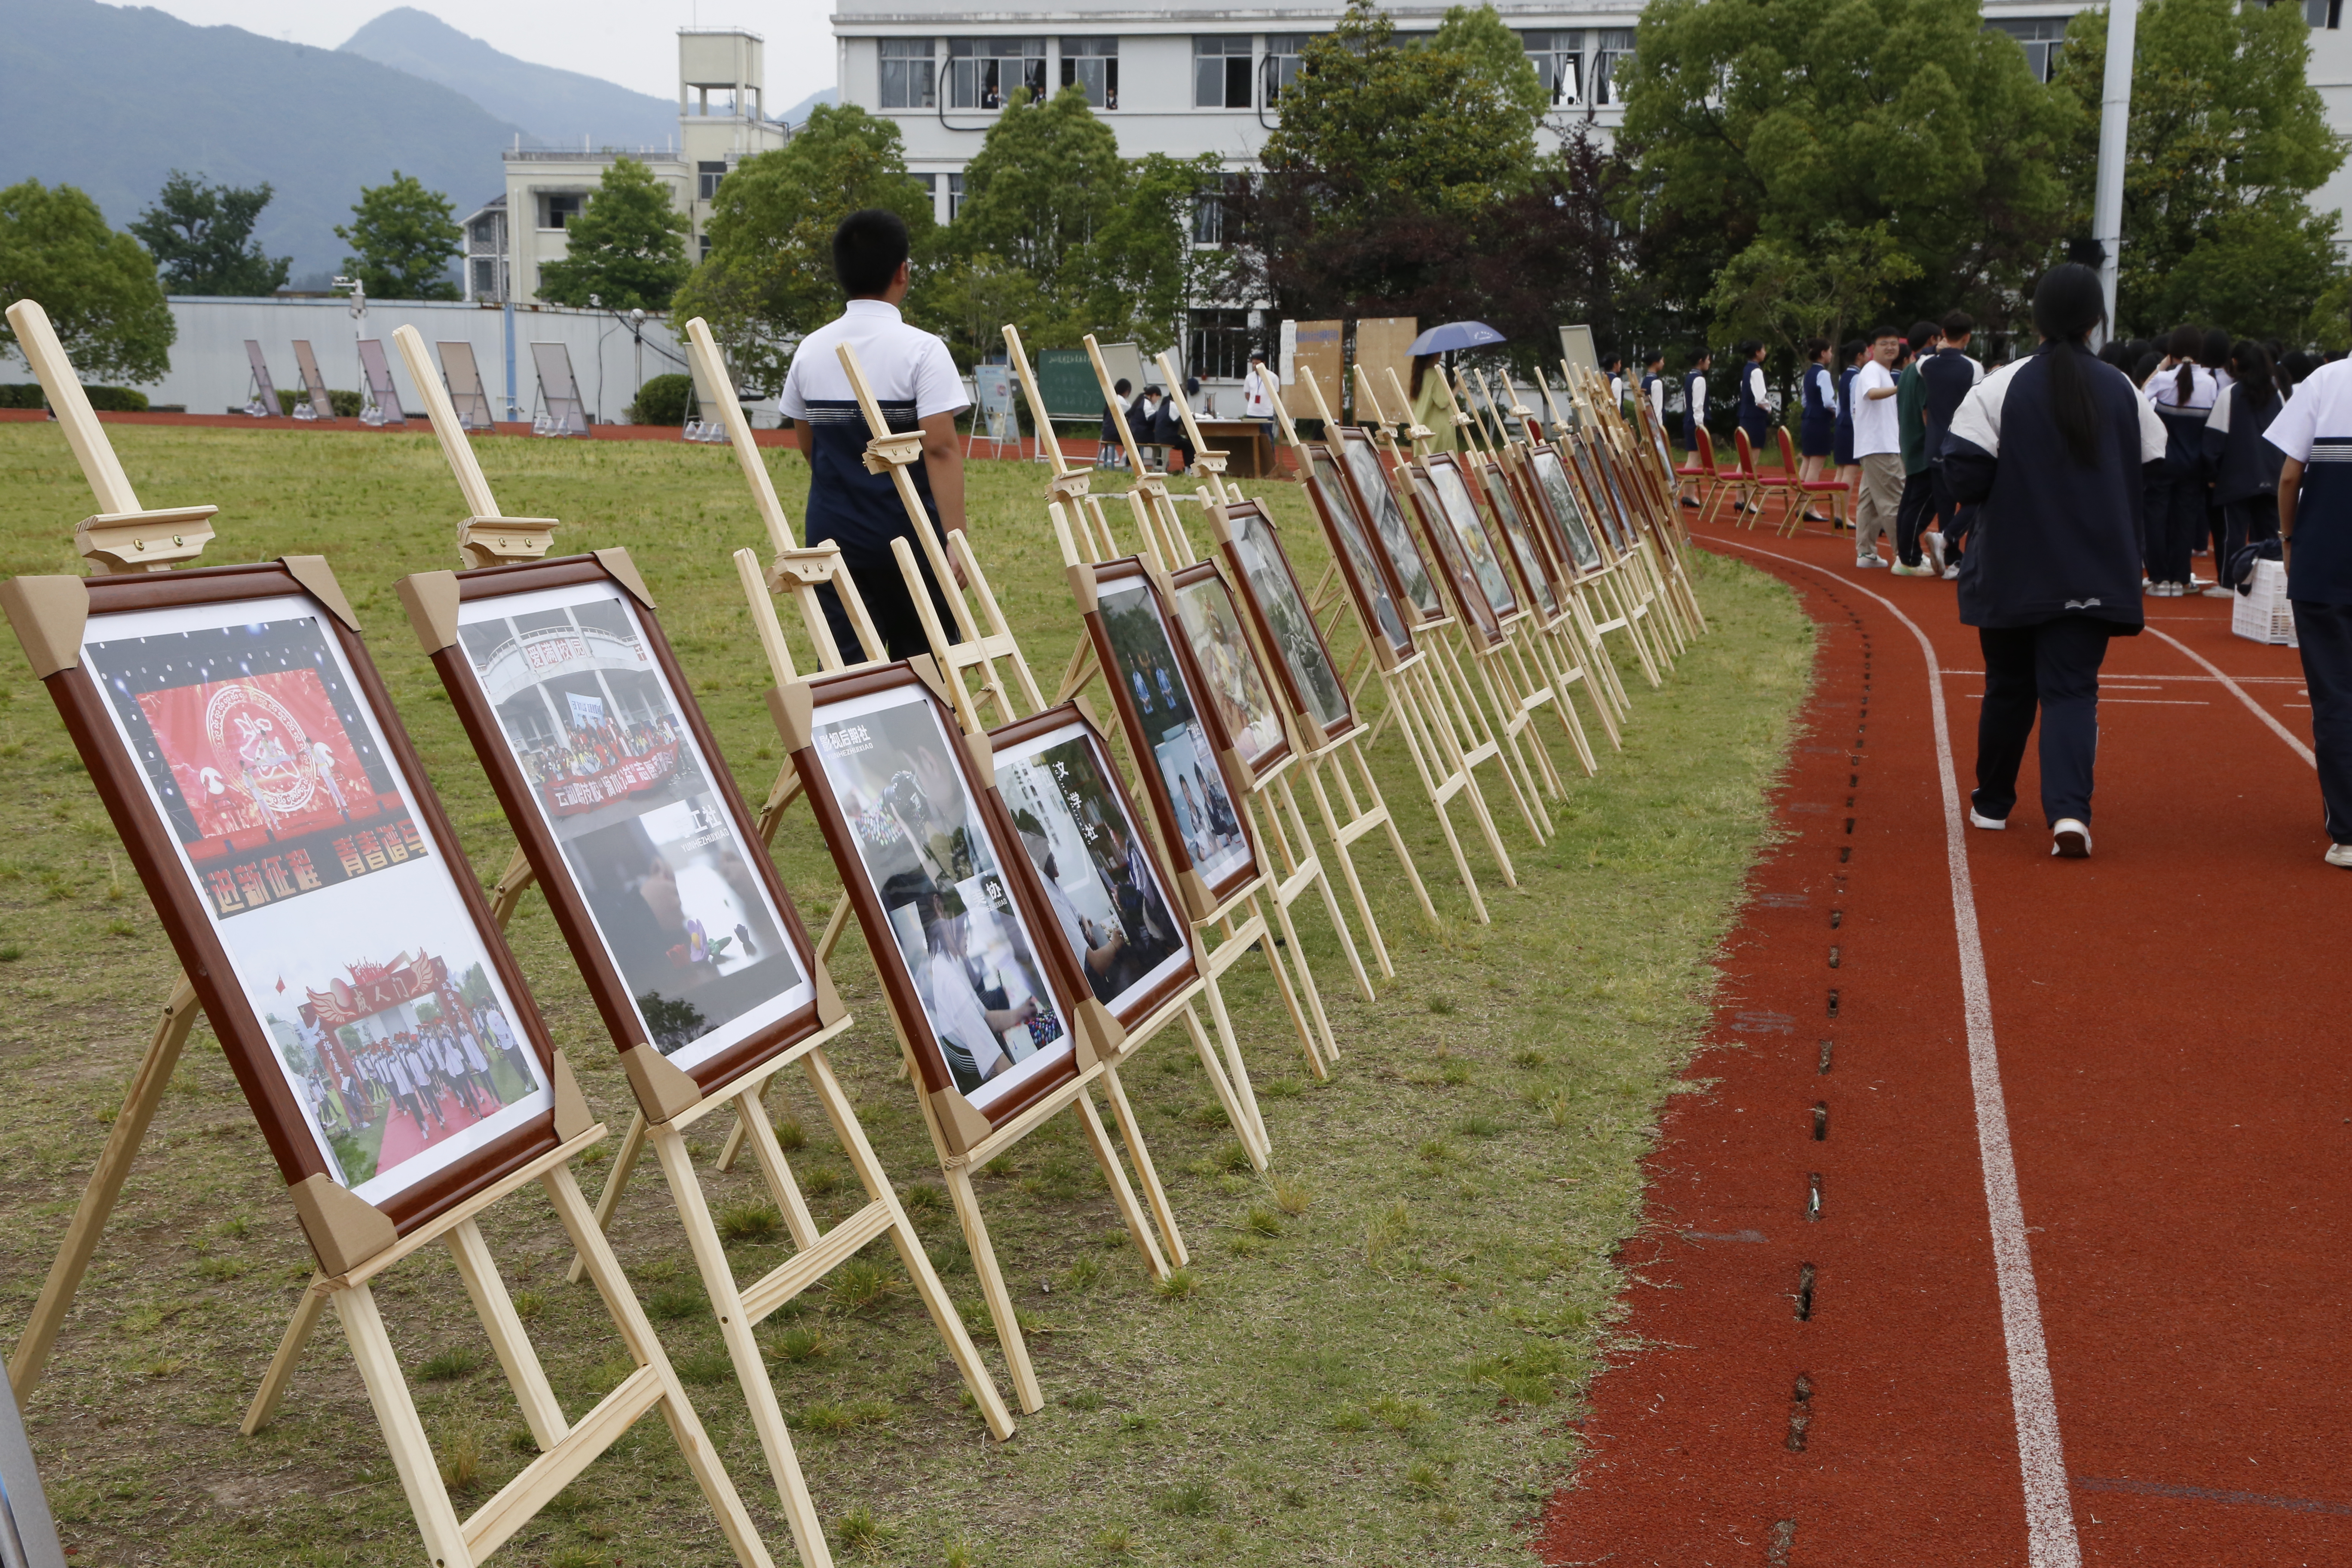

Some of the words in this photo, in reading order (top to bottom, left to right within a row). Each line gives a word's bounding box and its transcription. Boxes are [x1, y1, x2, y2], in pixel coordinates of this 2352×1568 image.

[527, 638, 586, 668] 爱满校园
[819, 724, 871, 752] 影视后期社
[1055, 760, 1098, 841] 文学社
[680, 827, 730, 853] YUNHEZHIJIXIAO
[199, 848, 322, 916] 进新征程
[353, 976, 410, 1013] 成人门
